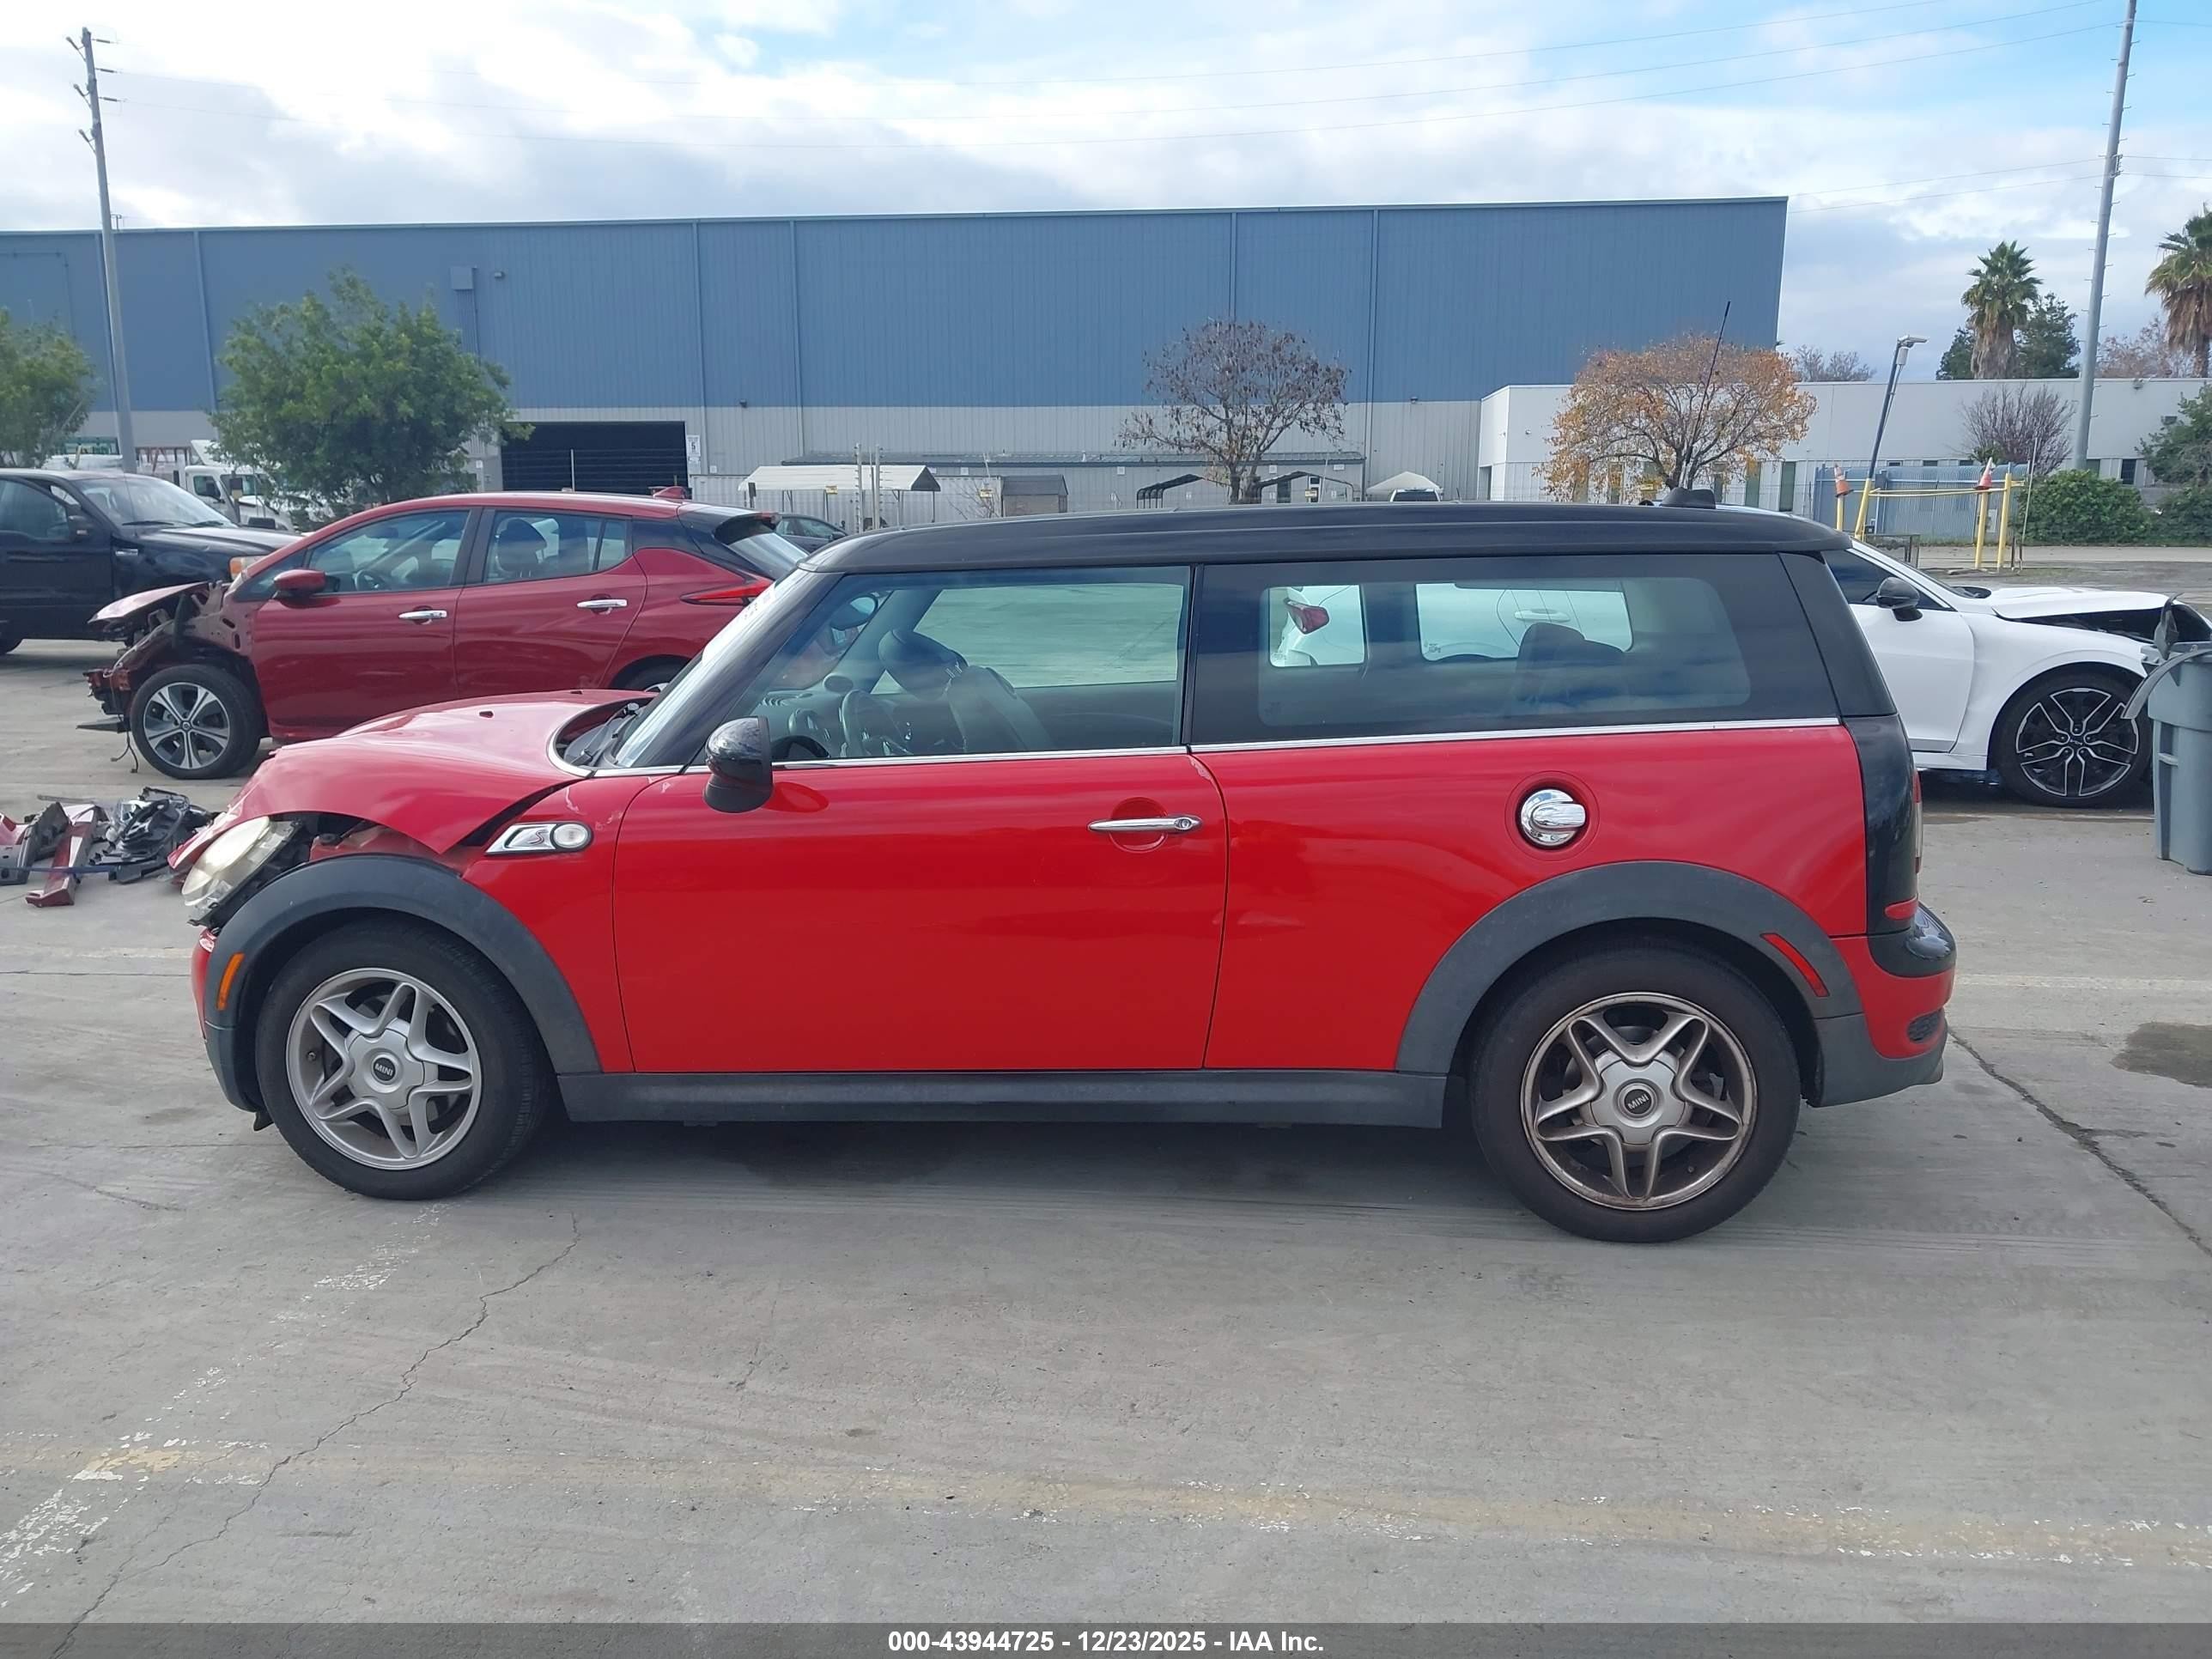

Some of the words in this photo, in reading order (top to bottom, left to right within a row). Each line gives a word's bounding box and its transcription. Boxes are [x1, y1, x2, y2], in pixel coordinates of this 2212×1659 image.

[528, 829, 549, 846] S
[374, 1063, 394, 1077] MINI
[1627, 1093, 1650, 1109] MINI
